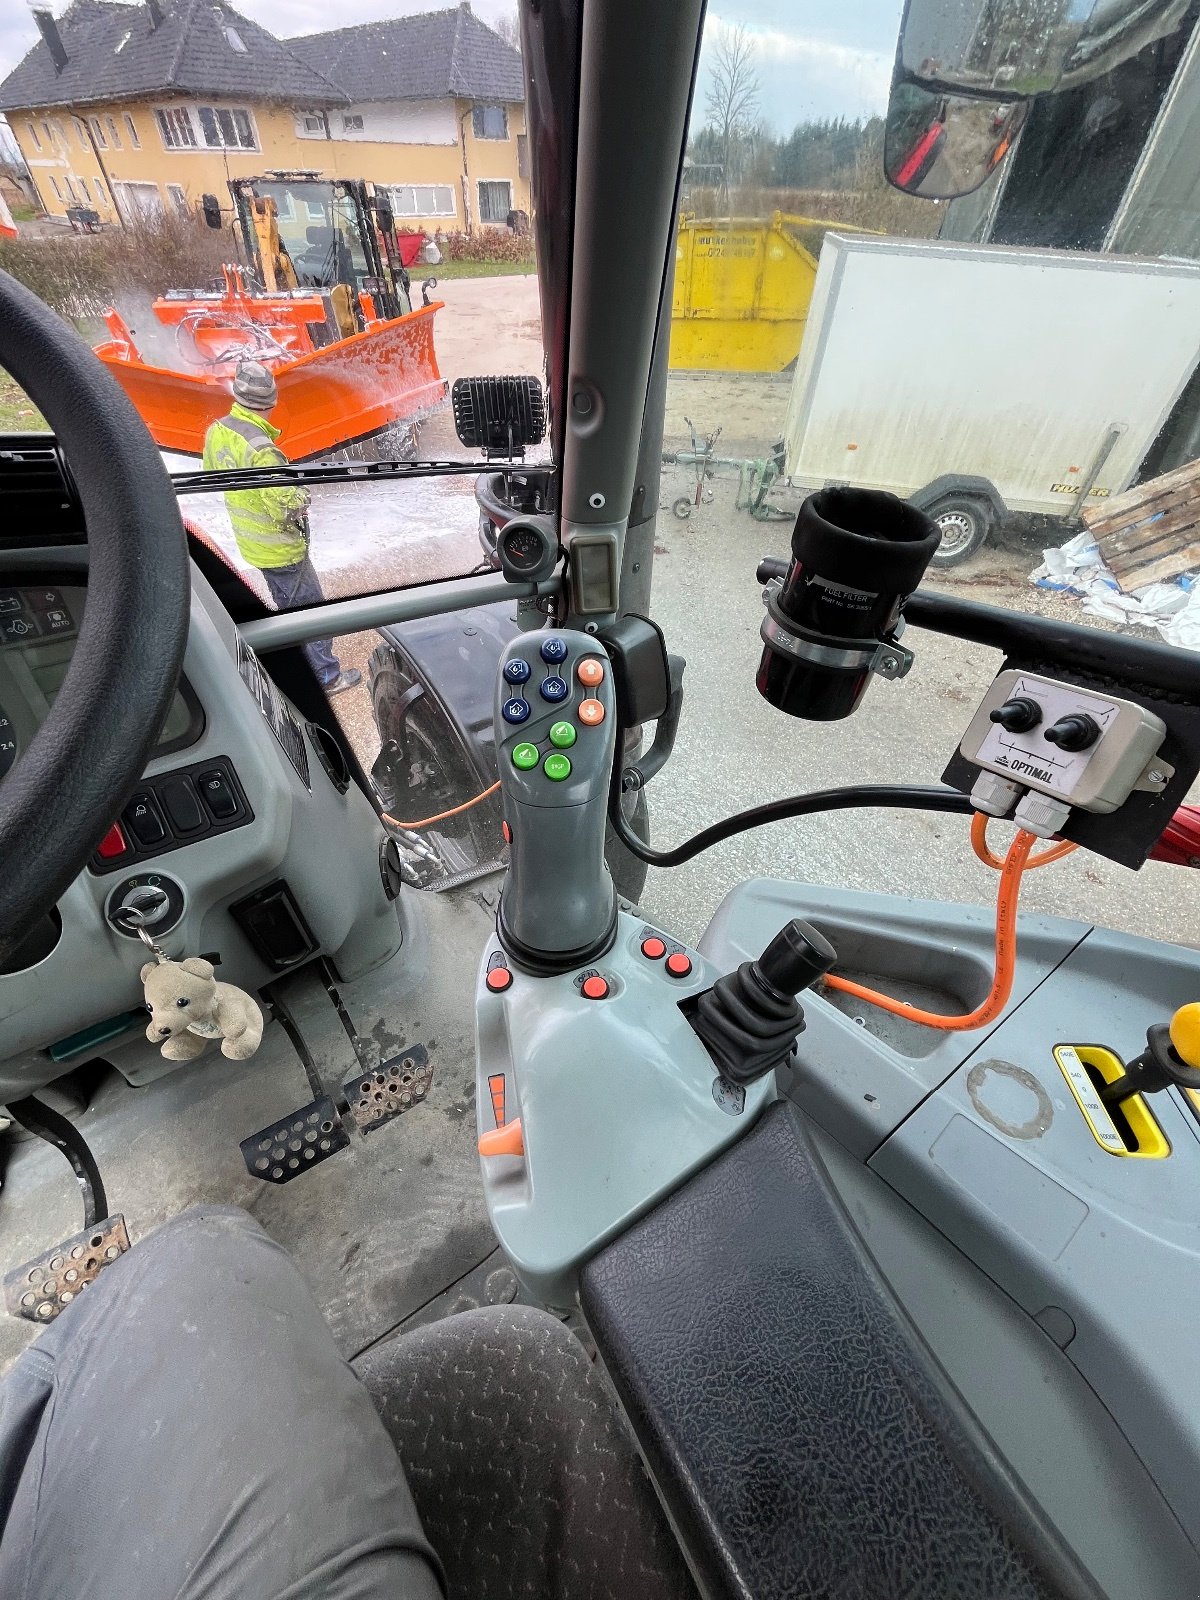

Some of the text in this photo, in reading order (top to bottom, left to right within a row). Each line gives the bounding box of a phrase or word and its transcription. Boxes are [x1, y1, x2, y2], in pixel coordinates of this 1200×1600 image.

[824, 587, 867, 603] FUEL FILTER
[52, 620, 70, 628] AUTO
[1, 741, 14, 750] 24
[1011, 760, 1053, 784] OPTIMAL
[1000, 927, 1004, 935] in
